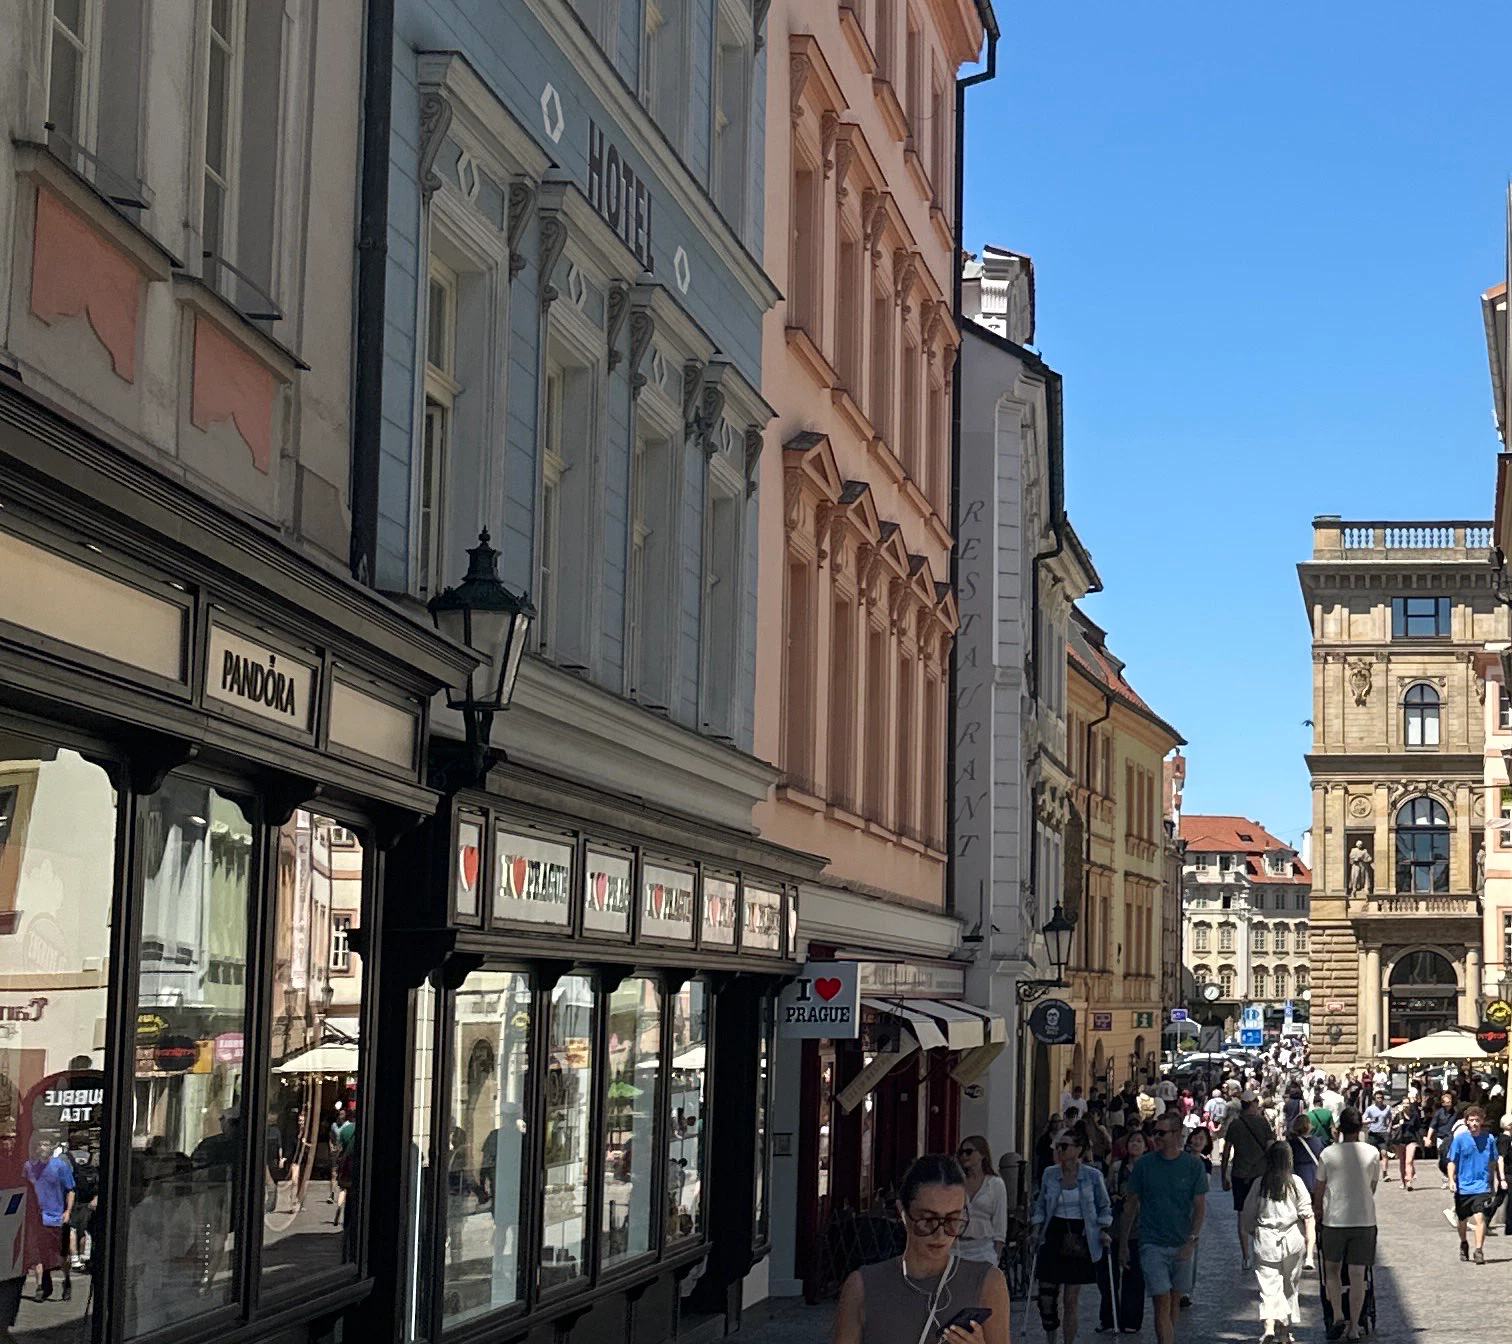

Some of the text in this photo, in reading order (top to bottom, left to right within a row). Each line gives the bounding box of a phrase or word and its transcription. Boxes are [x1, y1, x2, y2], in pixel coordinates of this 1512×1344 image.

[588, 116, 654, 274] HOTEL
[221, 649, 296, 716] PANDORA
[955, 499, 988, 858] RESTAURANT
[785, 1006, 850, 1023] PRAGUE
[796, 979, 812, 1002] I
